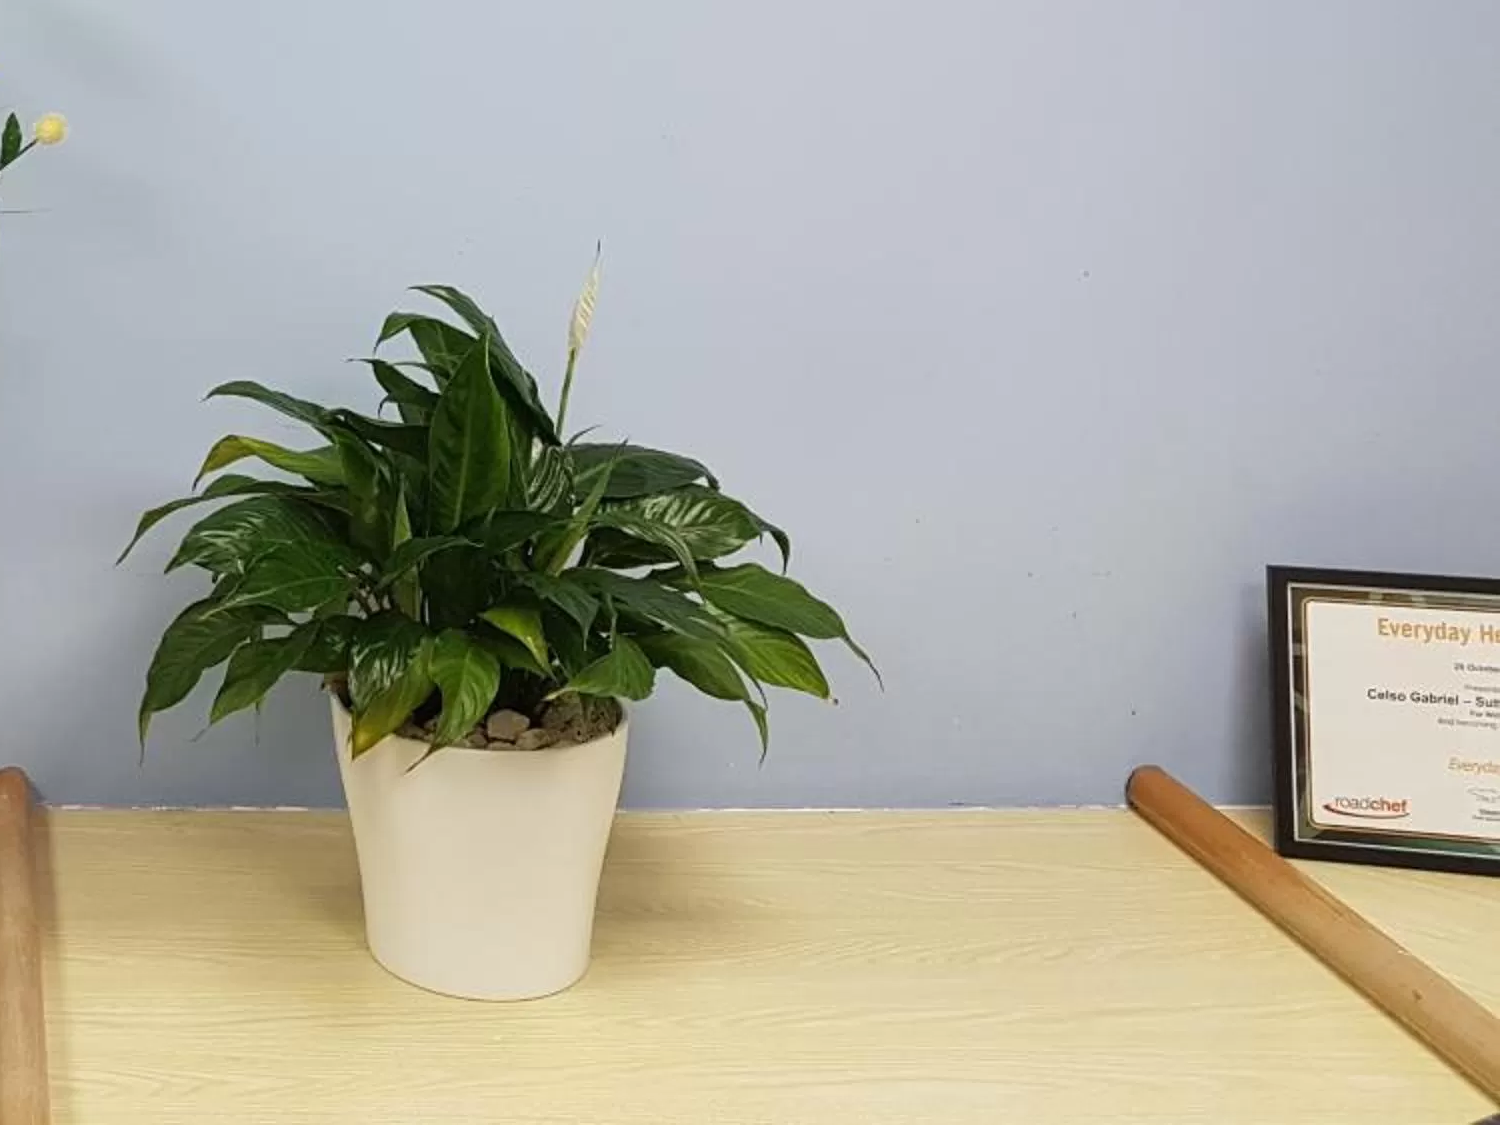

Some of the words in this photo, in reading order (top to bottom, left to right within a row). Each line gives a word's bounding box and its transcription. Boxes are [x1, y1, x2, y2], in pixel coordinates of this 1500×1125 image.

[1377, 618, 1471, 646] Everyday
[1367, 688, 1407, 702] Celso
[1410, 690, 1459, 706] Gabriel
[1334, 795, 1408, 813] roadchef
